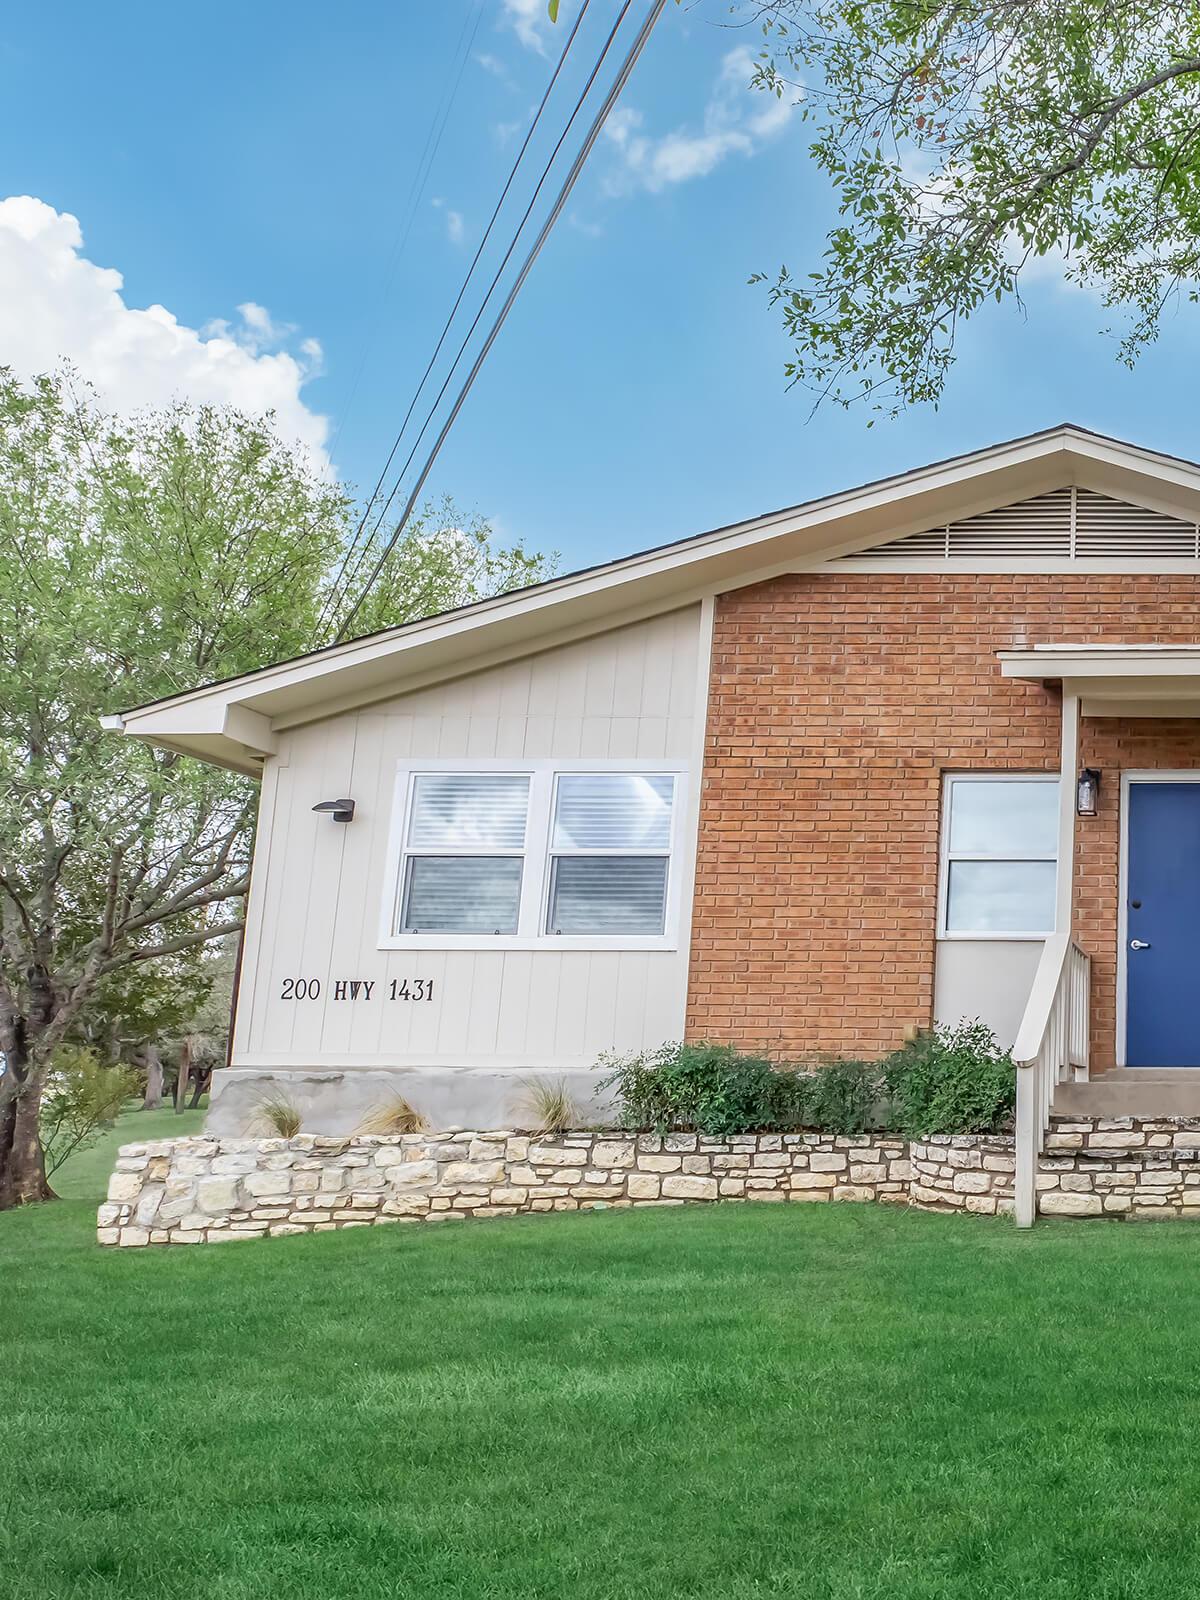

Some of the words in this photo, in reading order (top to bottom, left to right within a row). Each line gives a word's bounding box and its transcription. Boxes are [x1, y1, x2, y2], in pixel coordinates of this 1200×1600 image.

[281, 978, 321, 1001] 200
[334, 980, 376, 1001] HWY
[389, 979, 434, 1001] 1431
